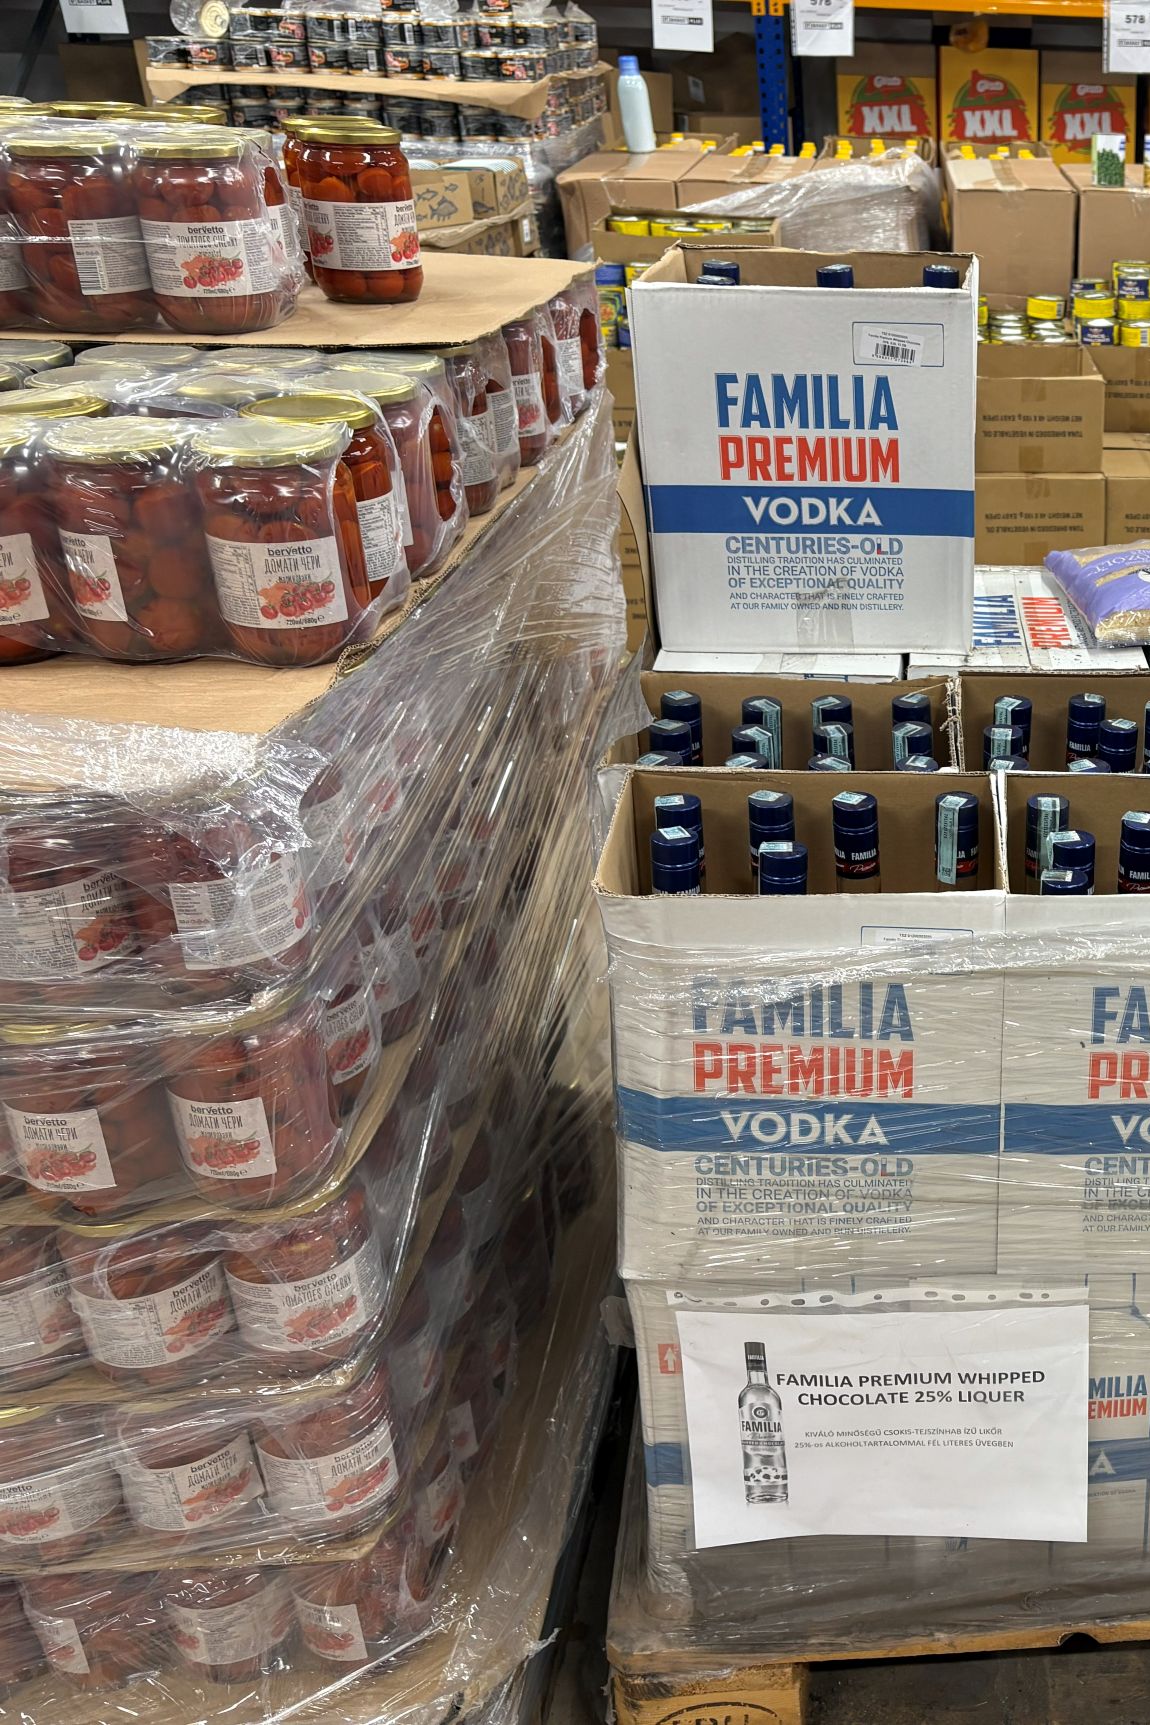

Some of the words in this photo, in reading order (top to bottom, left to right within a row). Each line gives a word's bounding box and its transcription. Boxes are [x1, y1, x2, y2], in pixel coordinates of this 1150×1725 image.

[861, 104, 917, 132] XXL
[962, 108, 1018, 137] XXL
[1063, 111, 1118, 139] XXL
[187, 225, 224, 234] bervetto
[714, 373, 899, 430] FAMILIA
[719, 435, 900, 483] PREMIUM
[742, 496, 884, 527] VODKA
[267, 545, 312, 557] bervetto
[725, 536, 904, 555] CENTURIES-OLD
[264, 557, 300, 575] ДОМАТИ
[302, 554, 321, 570] ЧЕРИ
[727, 556, 776, 565] DISTILLING
[778, 556, 825, 565] TRADITION
[826, 557, 845, 565] HAS
[847, 557, 903, 566] CULMINATED
[728, 566, 736, 576] IN
[745, 566, 770, 576] THE
[774, 566, 837, 576] CREATION
[840, 566, 858, 577] OF
[860, 566, 904, 577] VODKA
[728, 578, 746, 588] OF
[750, 578, 844, 589] EXCEPTIONAL
[847, 578, 905, 590] QUALITY
[730, 592, 748, 600] AND
[750, 592, 800, 600] CHARACTER
[730, 602, 742, 610] AT
[742, 602, 760, 610] OUR
[762, 602, 789, 610] FAMILY
[974, 594, 1022, 647] FAMILIA
[1021, 596, 1073, 648] PREMIUM
[851, 848, 878, 861] FAMILIA
[692, 976, 915, 1042] FAMILIA
[692, 1040, 915, 1098] PREMIUM
[191, 1104, 233, 1116] bervetto
[24, 1115, 67, 1126] bervetto
[189, 1115, 220, 1130] ДОМАТИ
[221, 1114, 242, 1128] ЧЕРИ
[720, 1110, 890, 1146] VODKA
[23, 1128, 55, 1141] ДОМАТИ
[694, 1154, 914, 1178] CENTURIES-OLD
[294, 1273, 337, 1294] bervetto
[776, 1373, 853, 1388] FAMILIA
[858, 1372, 952, 1387] PREMIUM
[957, 1370, 1046, 1385] WHIPPED
[1088, 1374, 1148, 1399] MILIA
[798, 1392, 910, 1406] CHOCOLATE
[914, 1390, 953, 1404] 25%
[958, 1390, 1026, 1404] LIQUER
[1088, 1398, 1147, 1420] EMIUM
[742, 1420, 782, 1432] FAMILIA
[804, 1429, 834, 1438] KIVÁLÓ
[836, 1428, 880, 1438] MINŐSÉGŰ
[883, 1428, 961, 1437] CSOKIS-TEJSZÍNHAB
[964, 1426, 977, 1436] ÍZŰ
[979, 1426, 1002, 1436] LIKŐR
[794, 1440, 824, 1448] 25%-os
[825, 1440, 926, 1448] ALKOHOLTARTALOMMAL
[928, 1438, 941, 1448] FÉL
[943, 1439, 974, 1447] LITERES
[976, 1438, 1014, 1448] ÜVEGBEN
